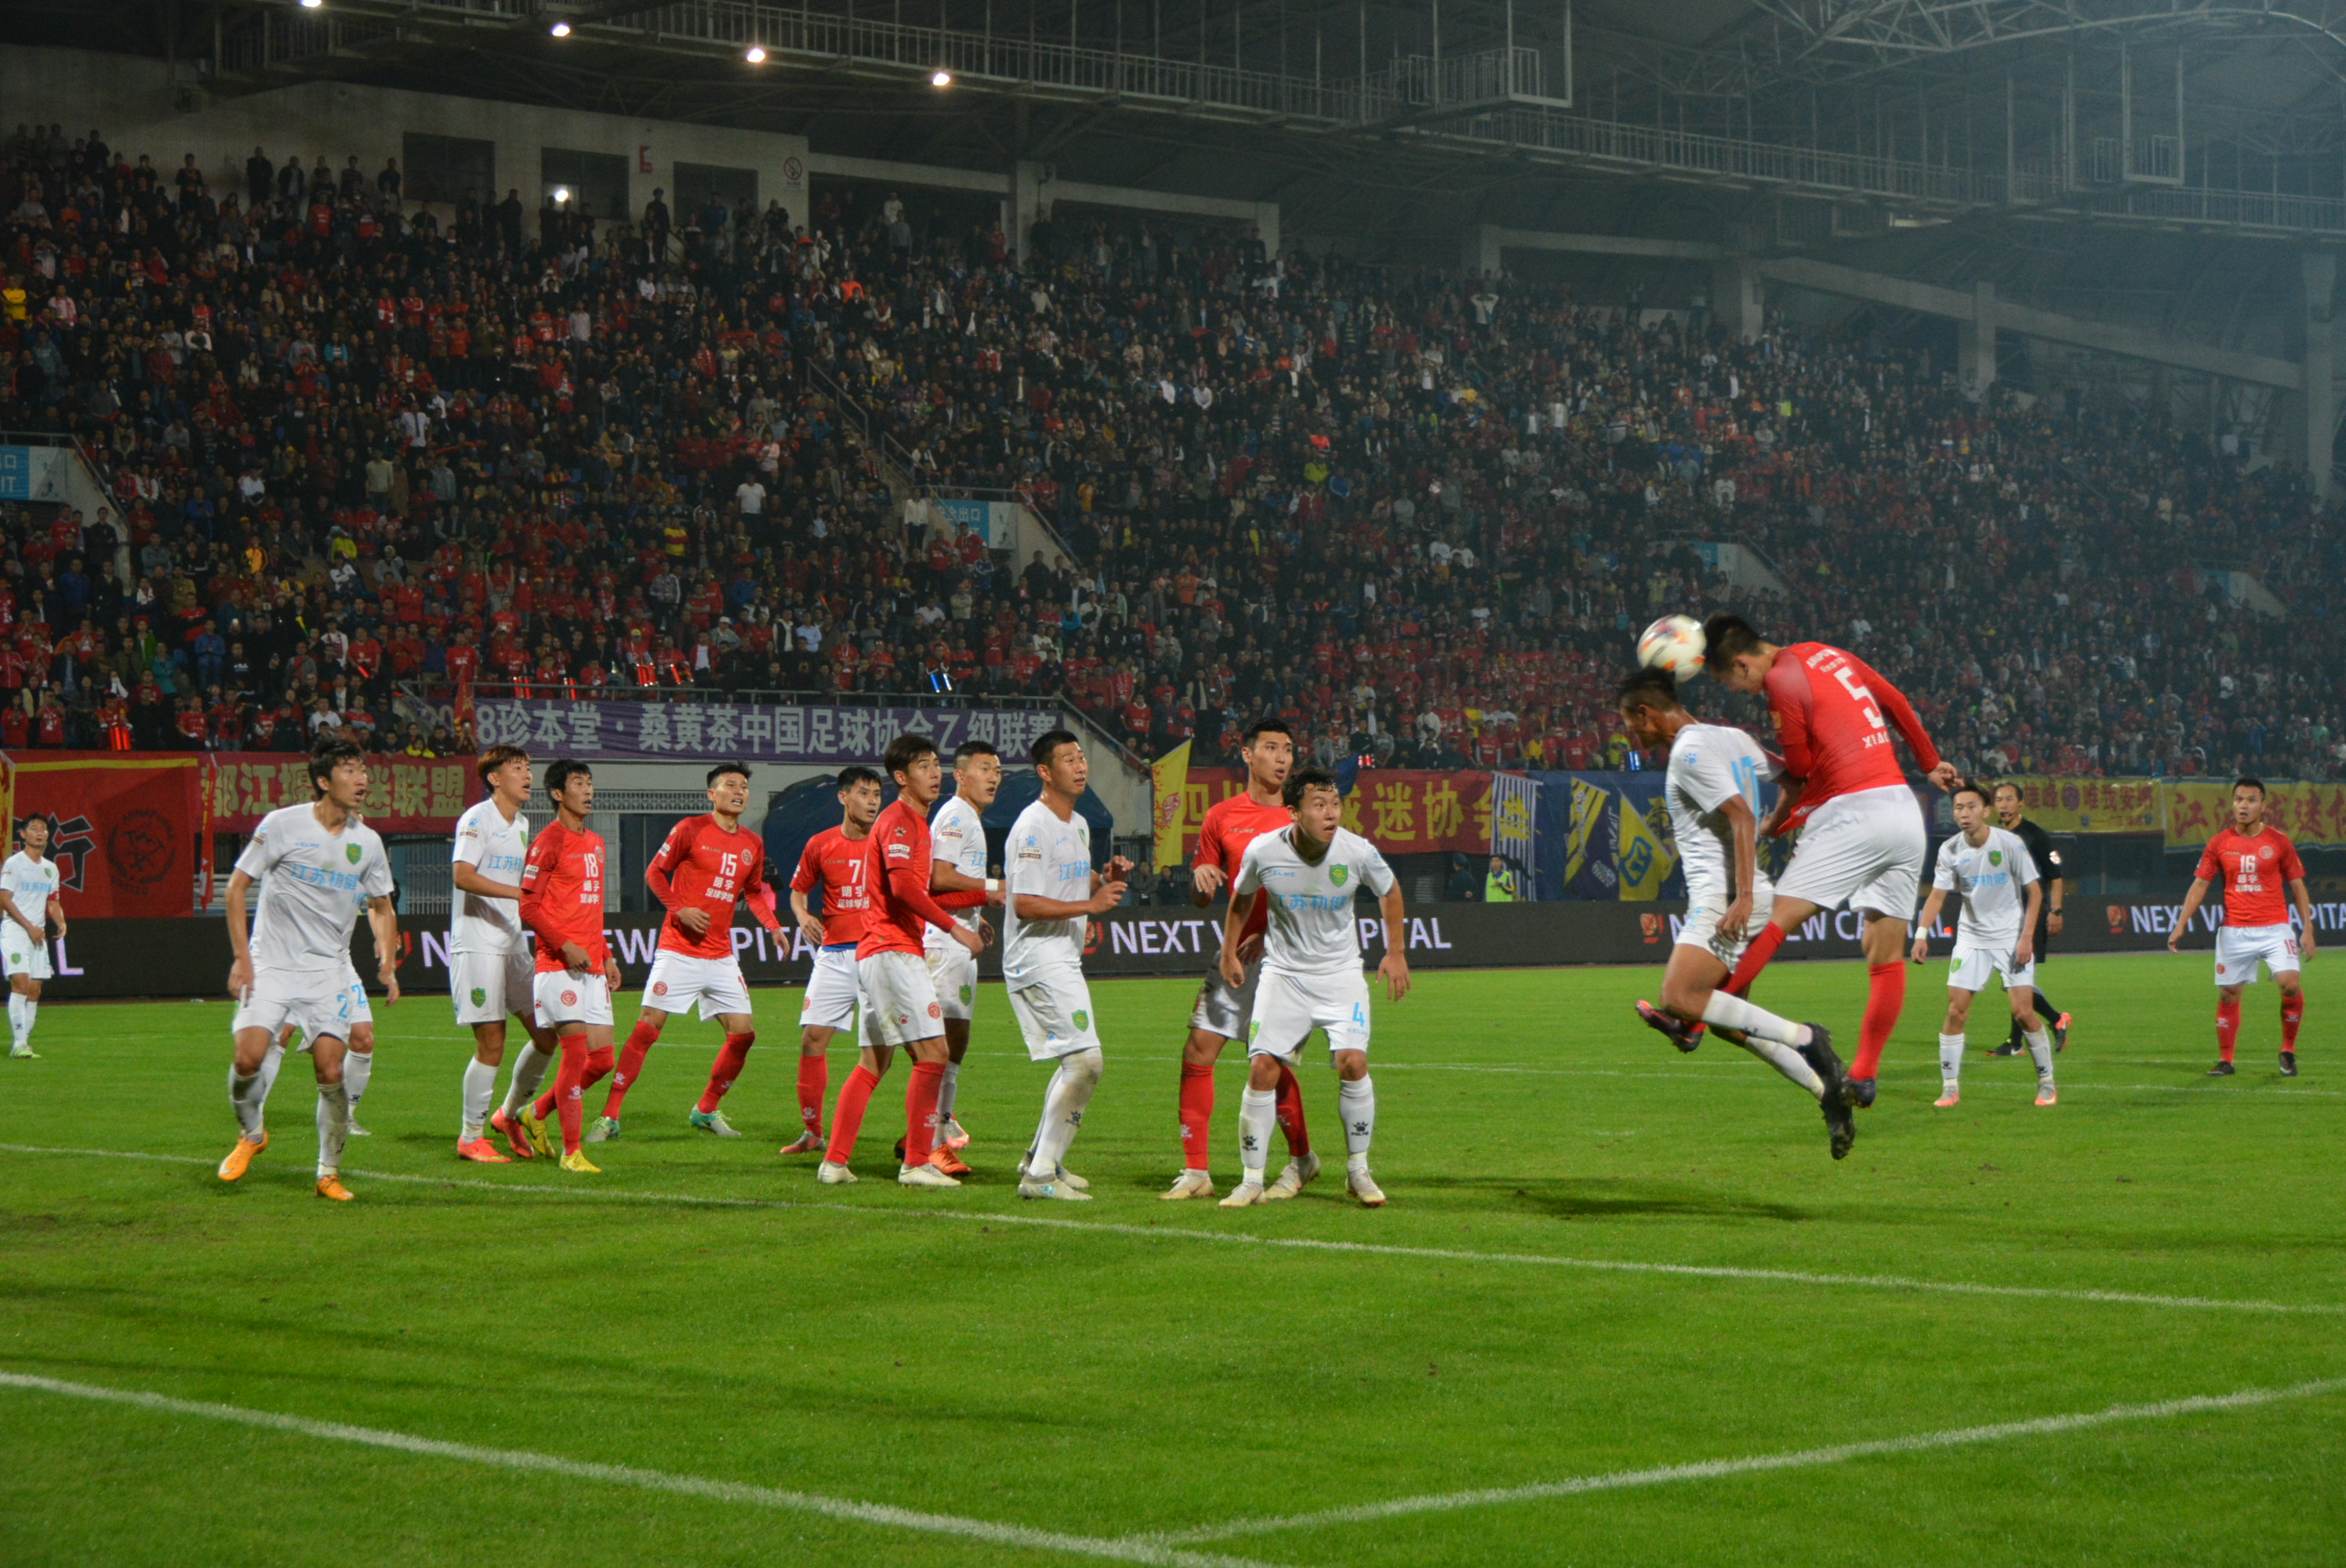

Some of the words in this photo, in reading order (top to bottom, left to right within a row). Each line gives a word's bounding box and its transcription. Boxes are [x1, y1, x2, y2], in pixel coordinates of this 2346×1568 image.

[1834, 666, 1885, 728] 5
[201, 762, 465, 818] 都江堰迷联盟
[583, 853, 599, 877] 18
[720, 852, 738, 877] 15
[848, 859, 862, 884] 7
[2239, 855, 2257, 873] 16
[705, 887, 735, 902] 足球学校
[713, 876, 735, 891] 明宇
[579, 893, 600, 905] 足球学
[837, 898, 862, 909] 足球学
[1110, 920, 1205, 955] NEXT
[1352, 1001, 1366, 1028] 4
